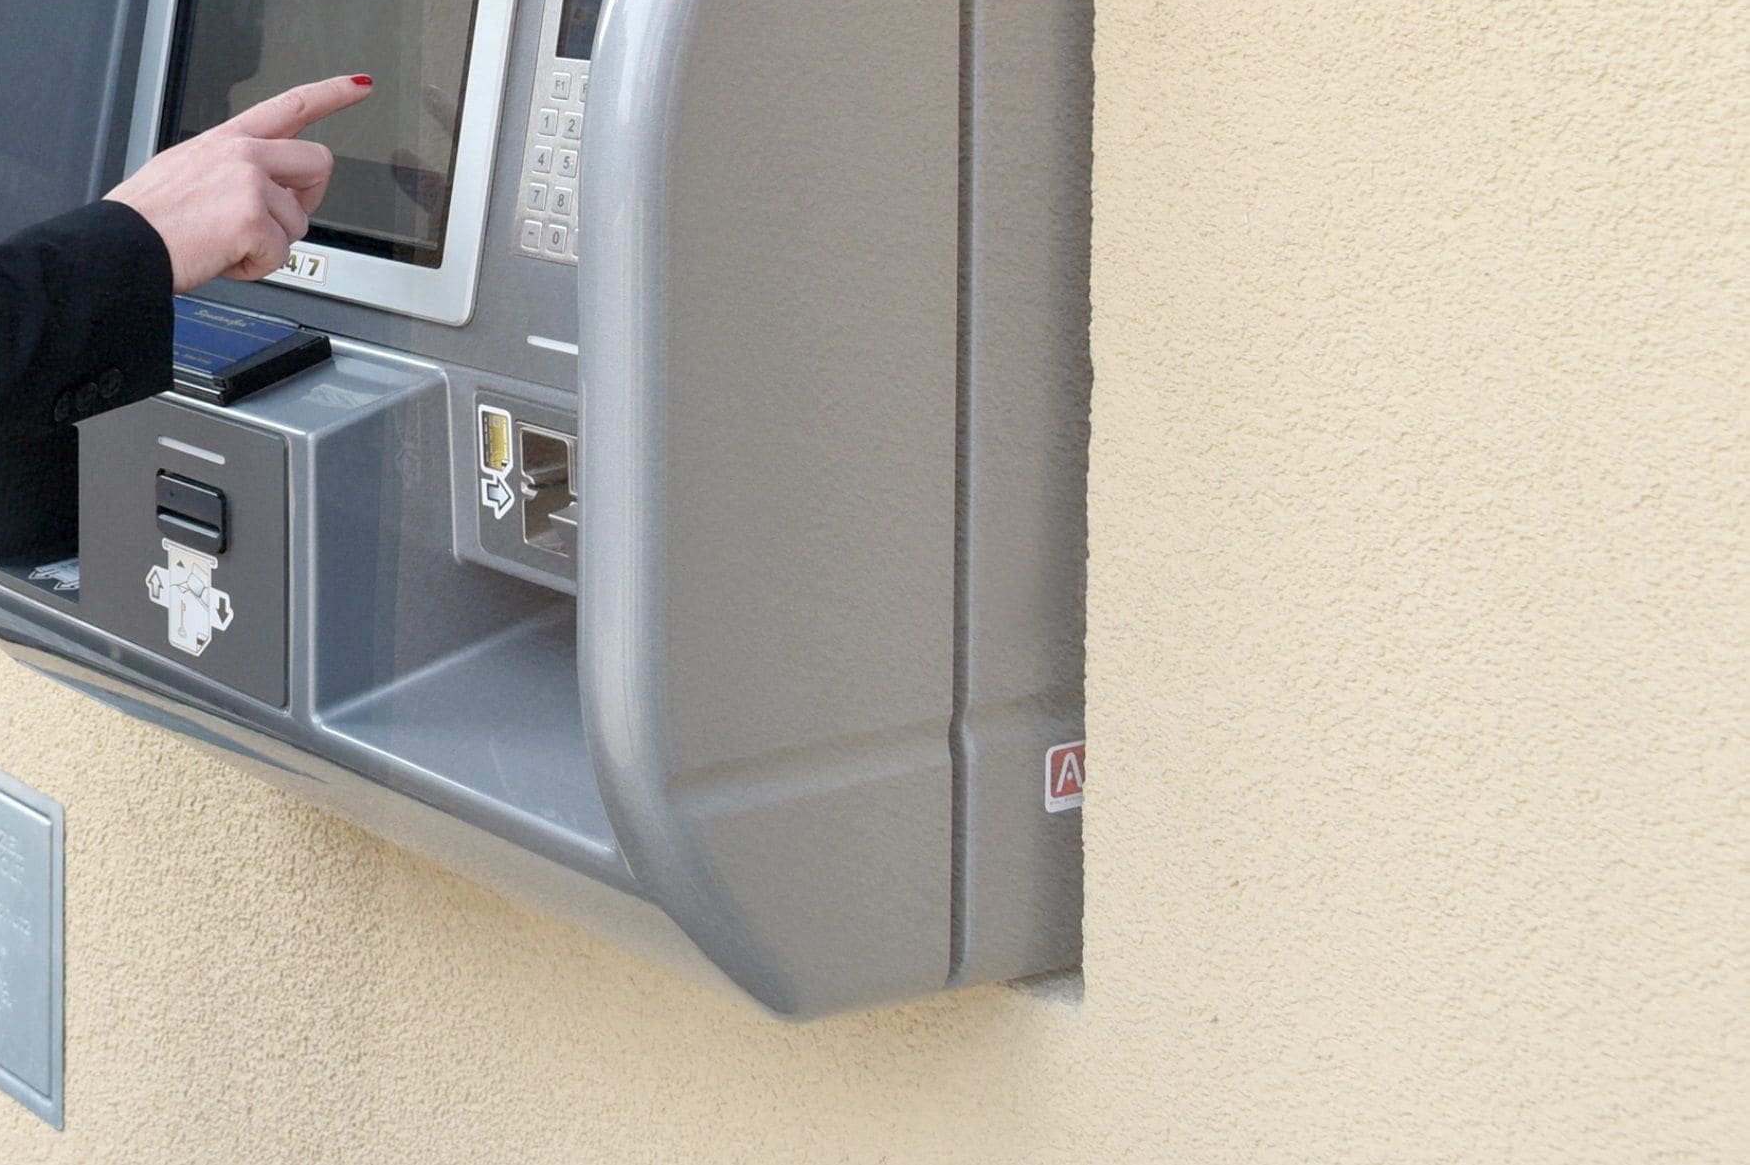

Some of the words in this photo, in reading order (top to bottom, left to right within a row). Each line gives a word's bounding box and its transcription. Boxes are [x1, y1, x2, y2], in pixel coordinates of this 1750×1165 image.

[554, 79, 566, 92] F1
[544, 115, 550, 129] 1
[567, 118, 576, 133] 2
[537, 152, 546, 166] 4
[562, 155, 571, 170] 5
[533, 189, 541, 203] 7
[556, 193, 565, 208] 8
[552, 230, 560, 245] 0
[280, 253, 321, 277] 4/7
